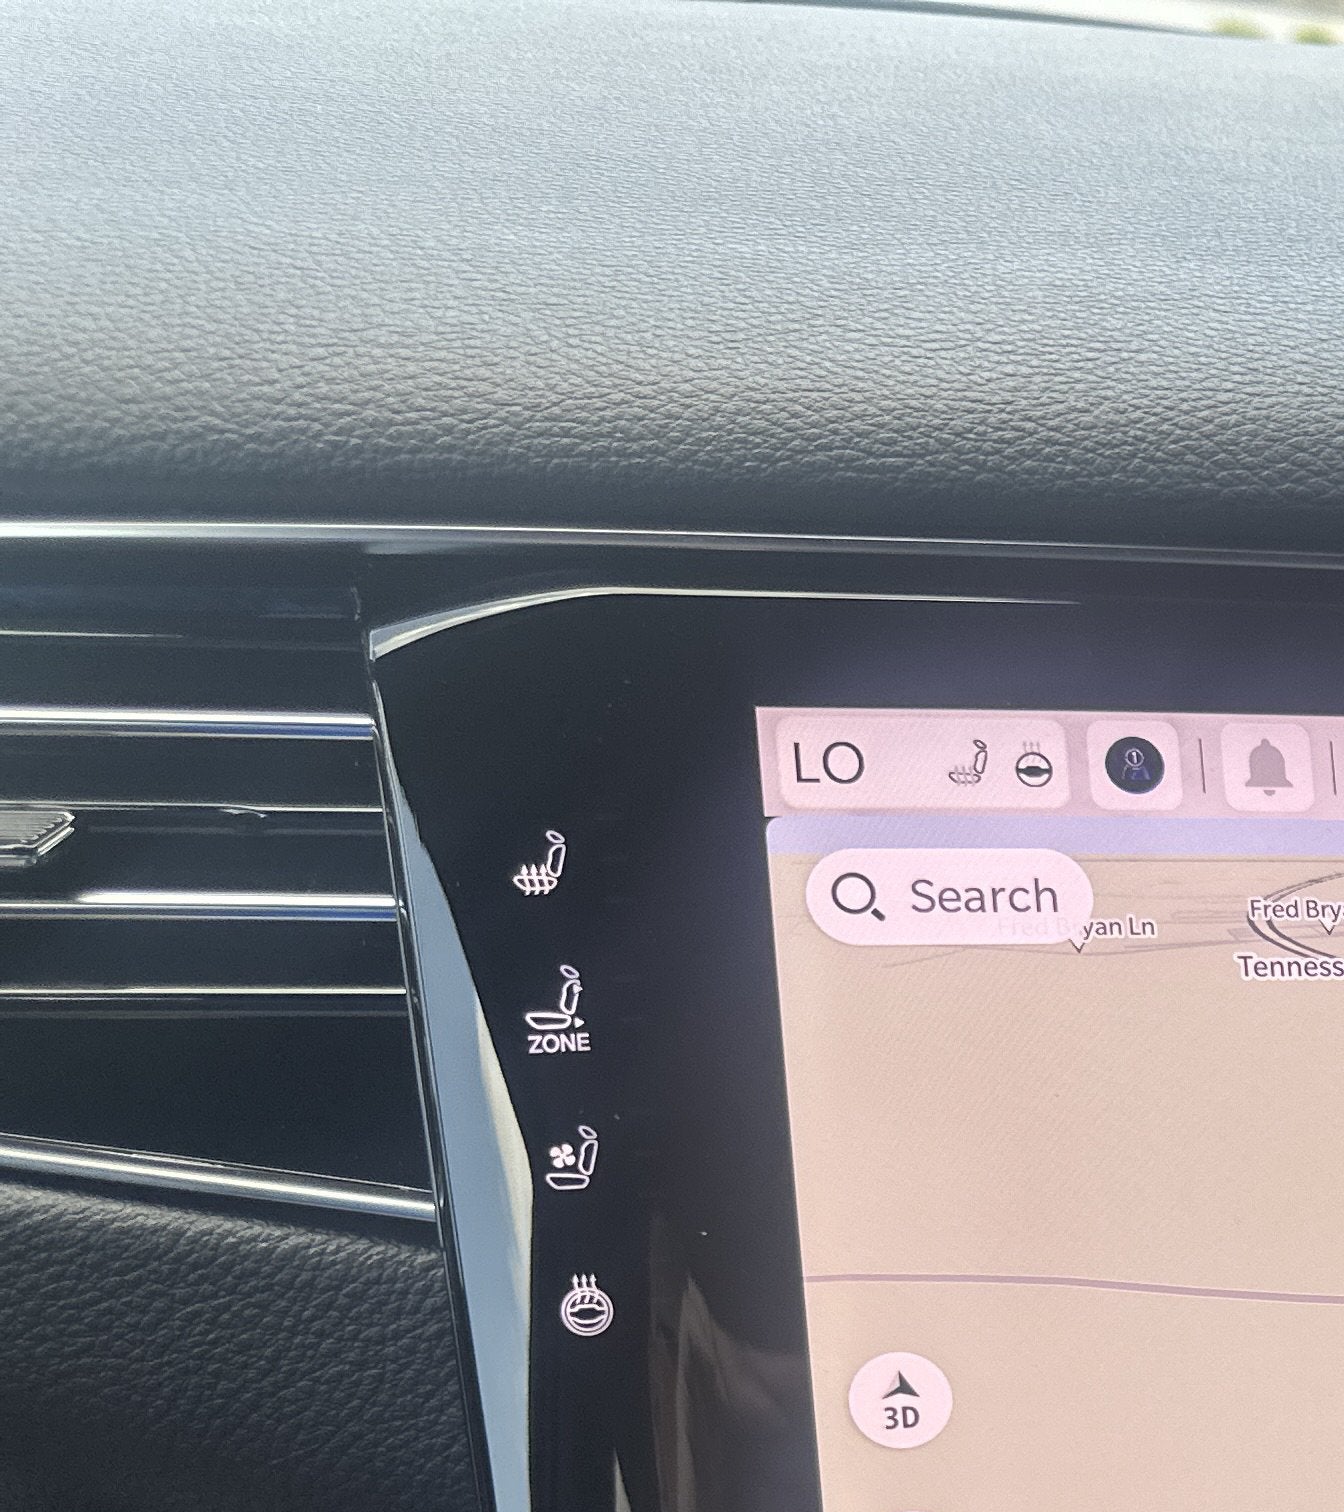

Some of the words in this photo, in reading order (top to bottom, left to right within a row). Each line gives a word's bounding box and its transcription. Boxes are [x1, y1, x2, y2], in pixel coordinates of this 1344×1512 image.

[792, 741, 866, 785] LO
[910, 877, 1060, 914] Search
[1250, 899, 1299, 919] Fred
[1128, 917, 1155, 936] Ln
[527, 1033, 592, 1055] ZONE
[883, 1405, 920, 1430] 3D
